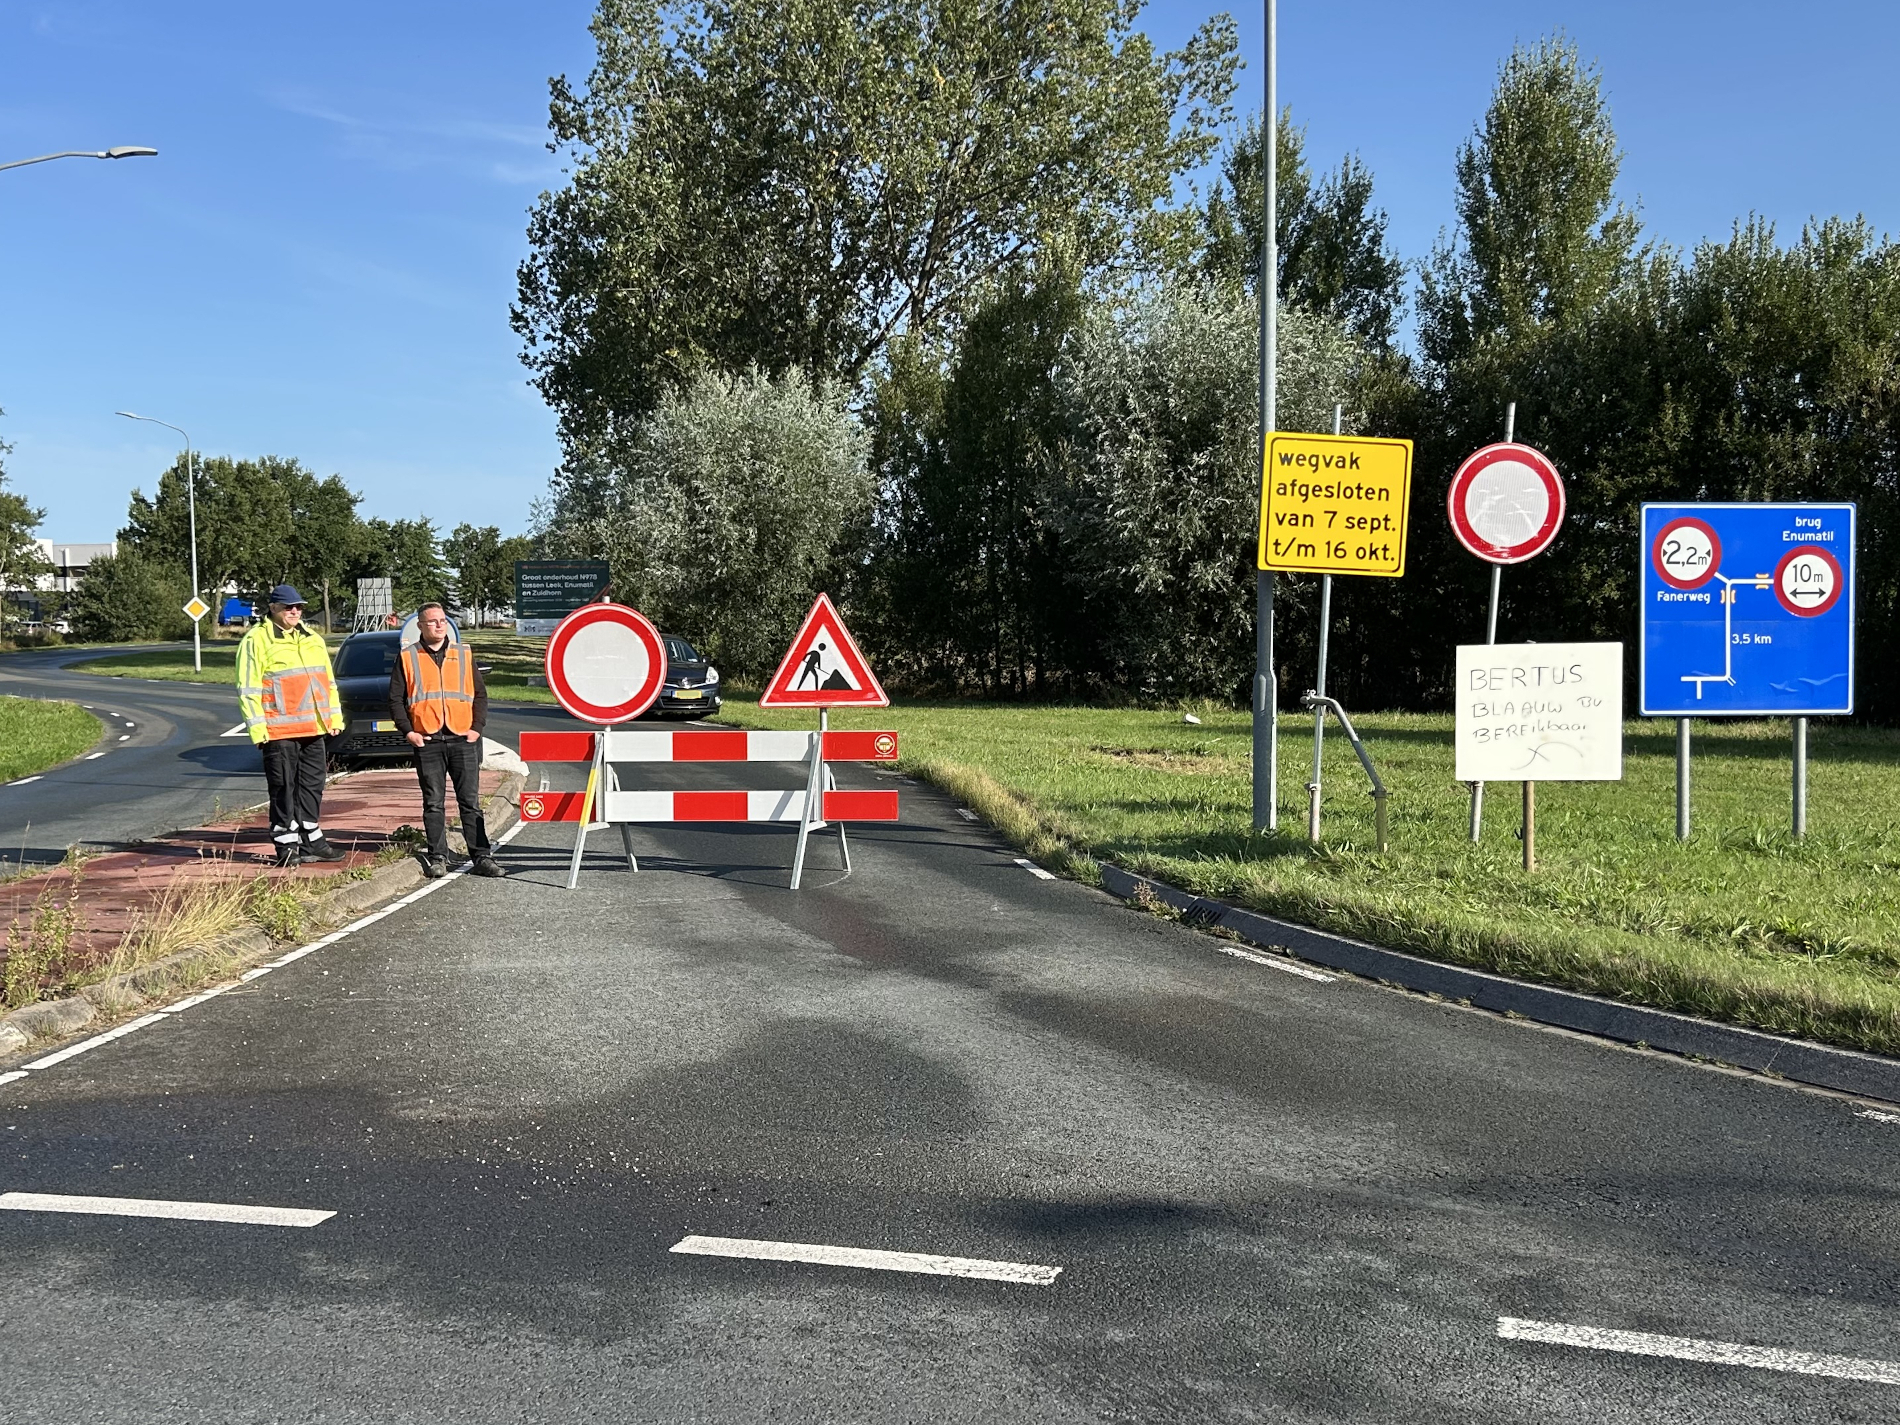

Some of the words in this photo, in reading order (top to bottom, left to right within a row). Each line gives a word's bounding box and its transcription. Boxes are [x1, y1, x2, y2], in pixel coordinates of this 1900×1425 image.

[1278, 451, 1361, 474] wegvak
[1275, 478, 1390, 503] afgesloten
[1275, 512, 1314, 528] van
[1323, 510, 1338, 529] 7
[1344, 513, 1396, 535] sept.
[1795, 516, 1822, 529] brug
[1782, 530, 1834, 542] Enumatil
[1272, 537, 1316, 558] t/m
[1325, 540, 1347, 559] 16
[1355, 542, 1396, 562] okt.
[521, 573, 542, 581] Groot
[543, 573, 579, 581] onderhoud
[1656, 590, 1711, 605] Fanerweg
[1731, 633, 1751, 645] 3,5
[1754, 633, 1772, 644] km
[1470, 664, 1583, 691] BERTUS
